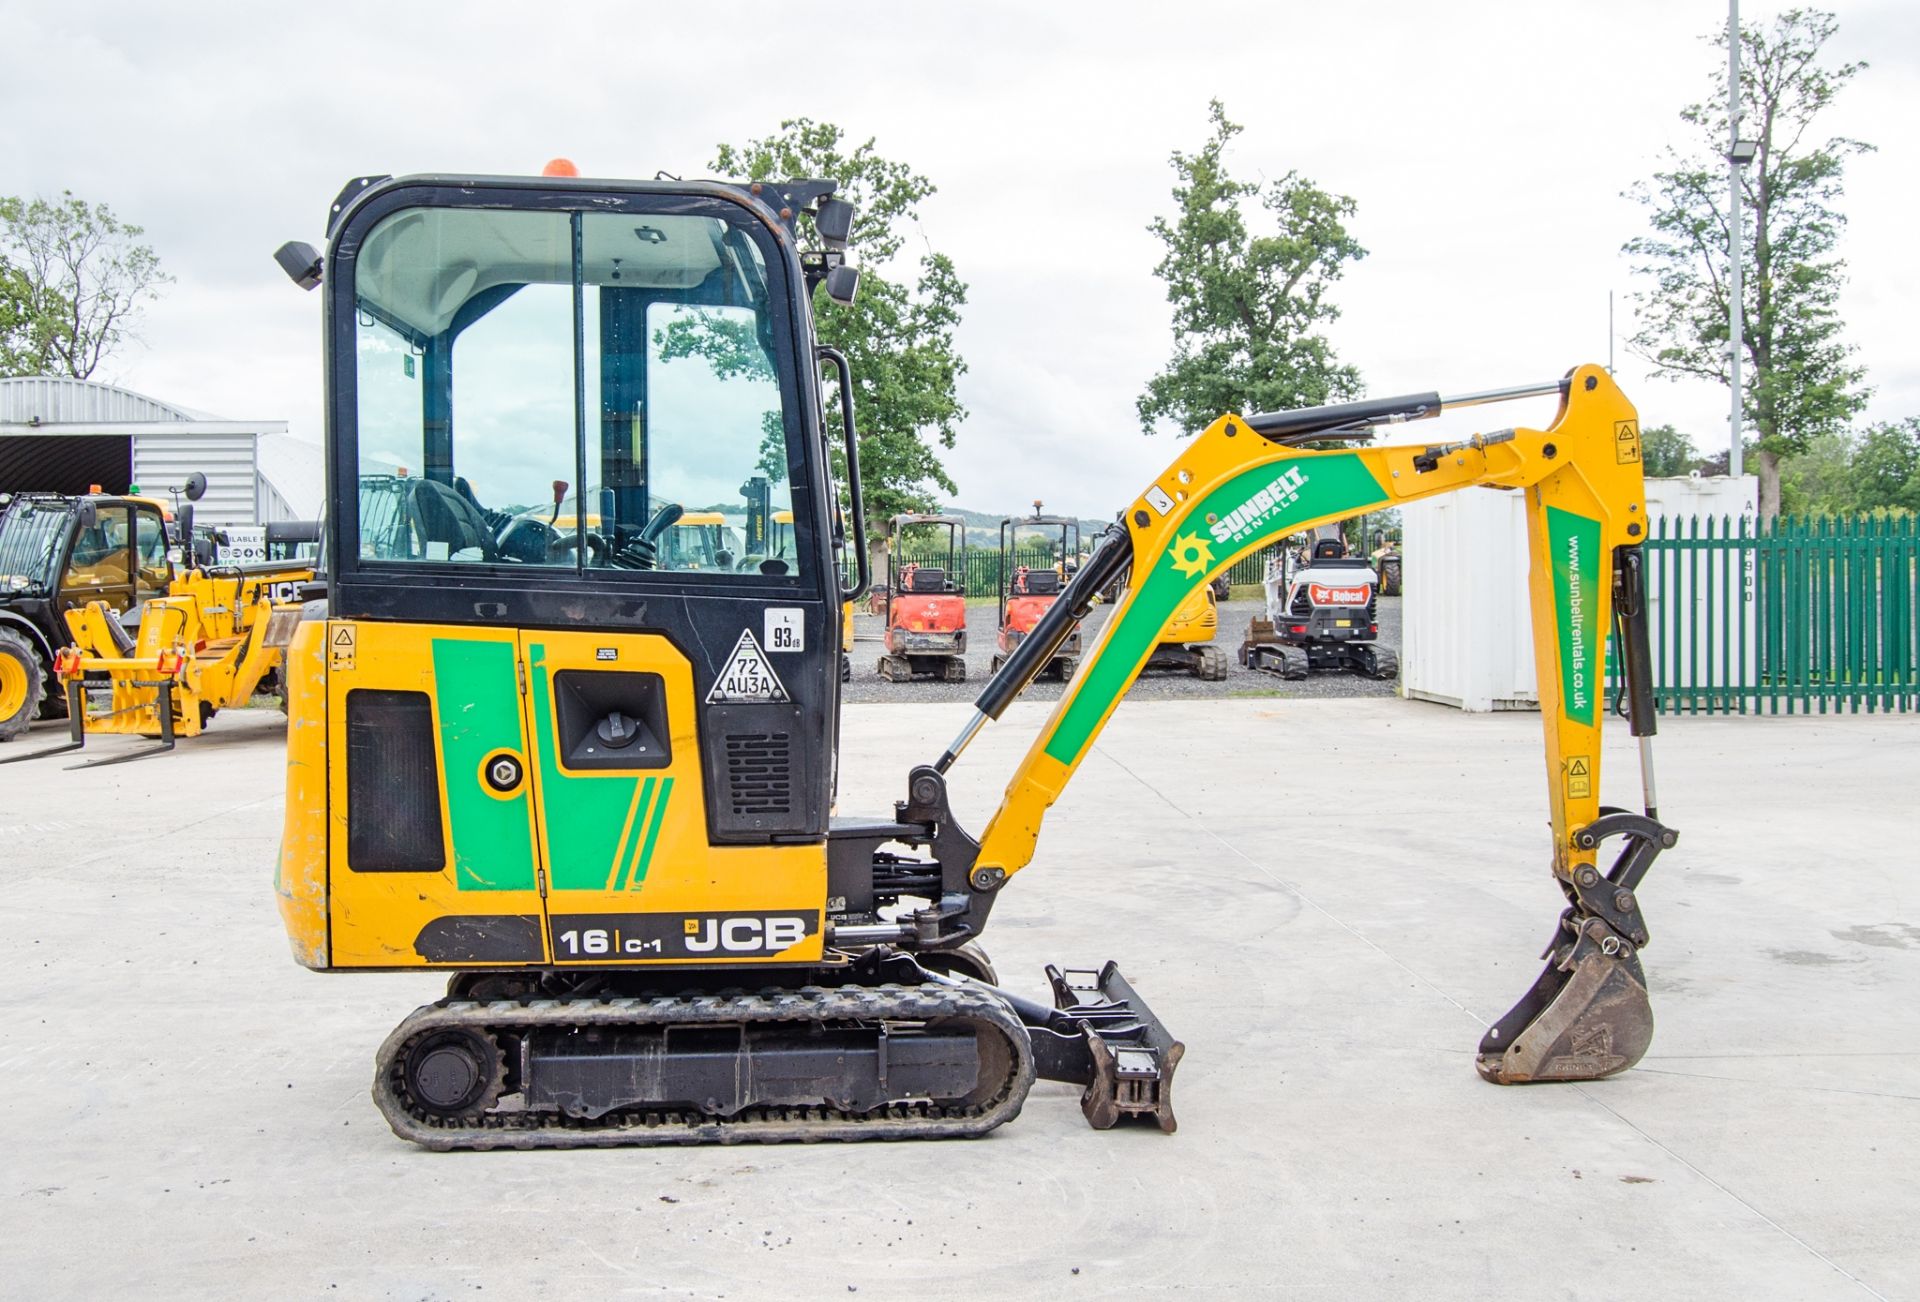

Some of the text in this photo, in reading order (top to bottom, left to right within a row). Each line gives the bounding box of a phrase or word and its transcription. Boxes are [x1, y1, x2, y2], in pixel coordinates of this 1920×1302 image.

[1209, 465, 1305, 544] SUNBELT
[1233, 491, 1299, 543] RENTALS
[1332, 590, 1364, 603] Bobcat
[1568, 535, 1587, 709] www.sunbeltrentals.co.uk
[774, 627, 792, 648] 93
[737, 658, 759, 676] 72
[726, 676, 771, 694] AU3A
[560, 929, 609, 954] 16
[684, 917, 806, 952] JCB
